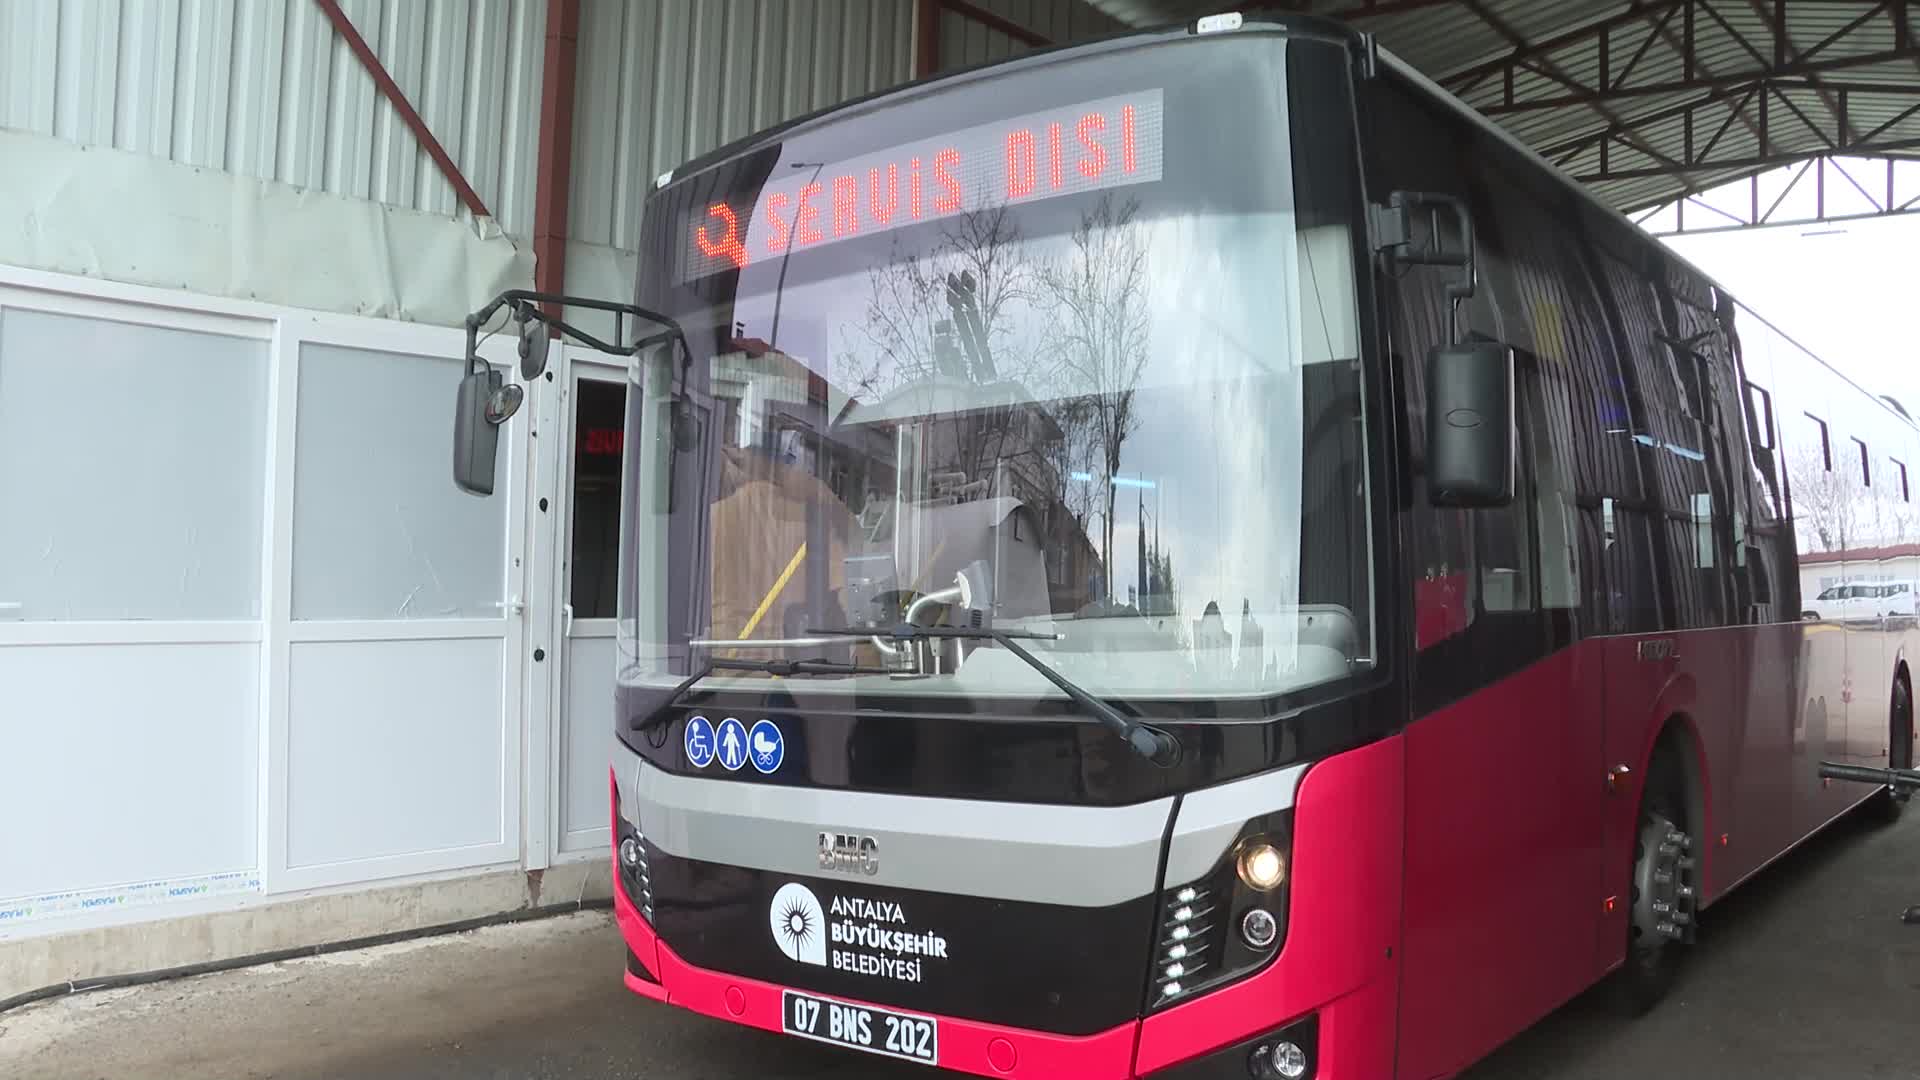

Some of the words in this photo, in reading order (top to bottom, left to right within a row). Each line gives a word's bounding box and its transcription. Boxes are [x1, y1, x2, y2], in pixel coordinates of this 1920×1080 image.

[818, 832, 879, 876] BMC
[830, 896, 906, 924] ANTALYA
[831, 919, 948, 958] BÜYÜKŞEHİR
[832, 950, 922, 983] BELEDİYESİ
[794, 997, 821, 1034] 07
[829, 1005, 872, 1046] BNS
[885, 1016, 932, 1058] 202
